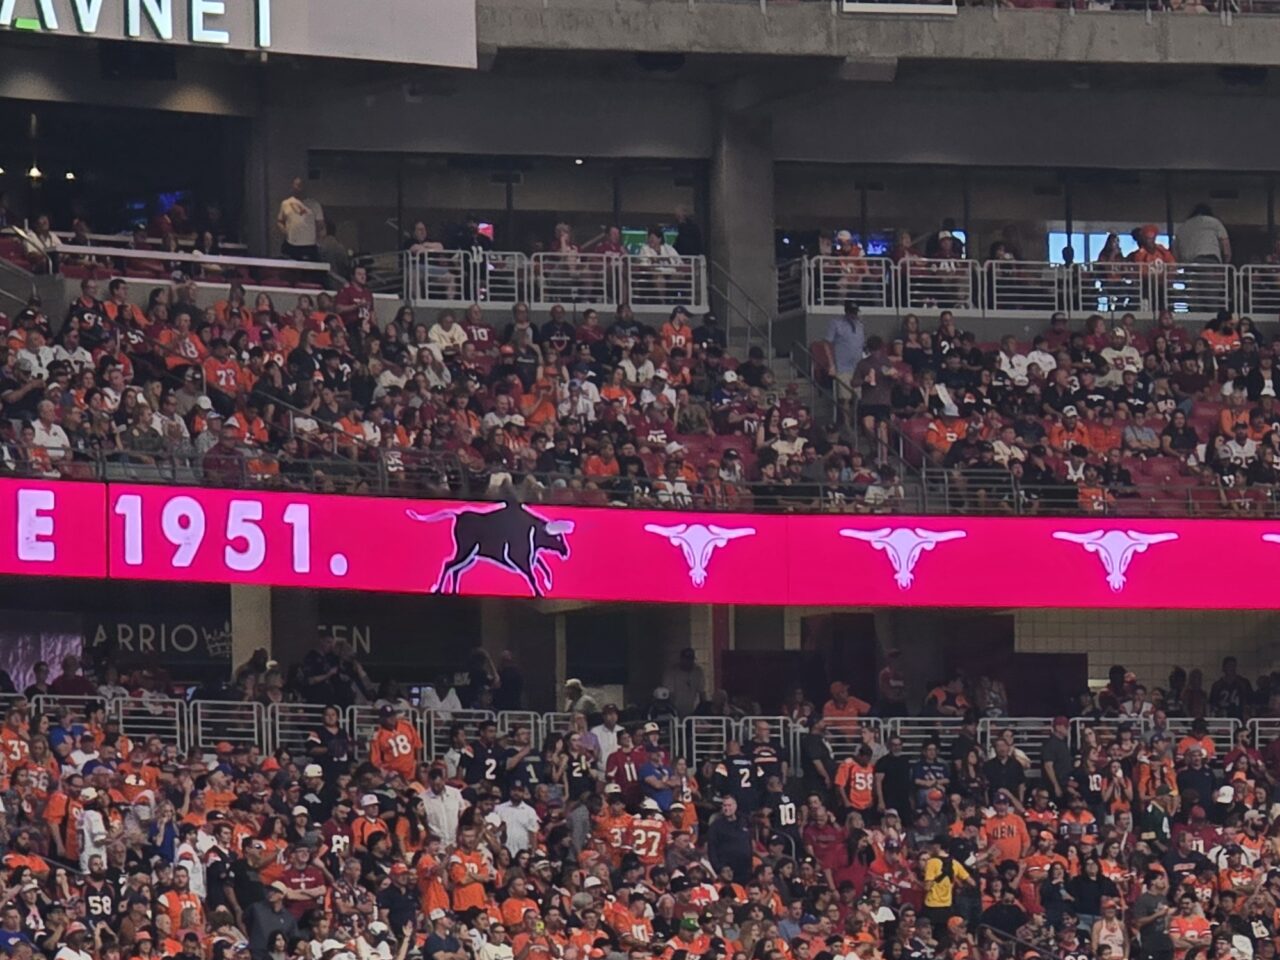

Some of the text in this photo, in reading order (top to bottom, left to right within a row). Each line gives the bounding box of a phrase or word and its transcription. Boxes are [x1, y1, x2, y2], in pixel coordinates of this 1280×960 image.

[473, 327, 488, 341] 10
[671, 335, 685, 348] 10
[18, 489, 349, 576] E 1951.
[318, 625, 371, 653] EN
[389, 737, 411, 756] 18
[485, 758, 496, 779] 2
[526, 764, 537, 783] 1
[625, 763, 638, 781] 11
[740, 768, 751, 788] 2
[856, 773, 873, 790] 58
[779, 803, 795, 826] 10
[633, 828, 660, 856] 27
[88, 896, 111, 914] 58
